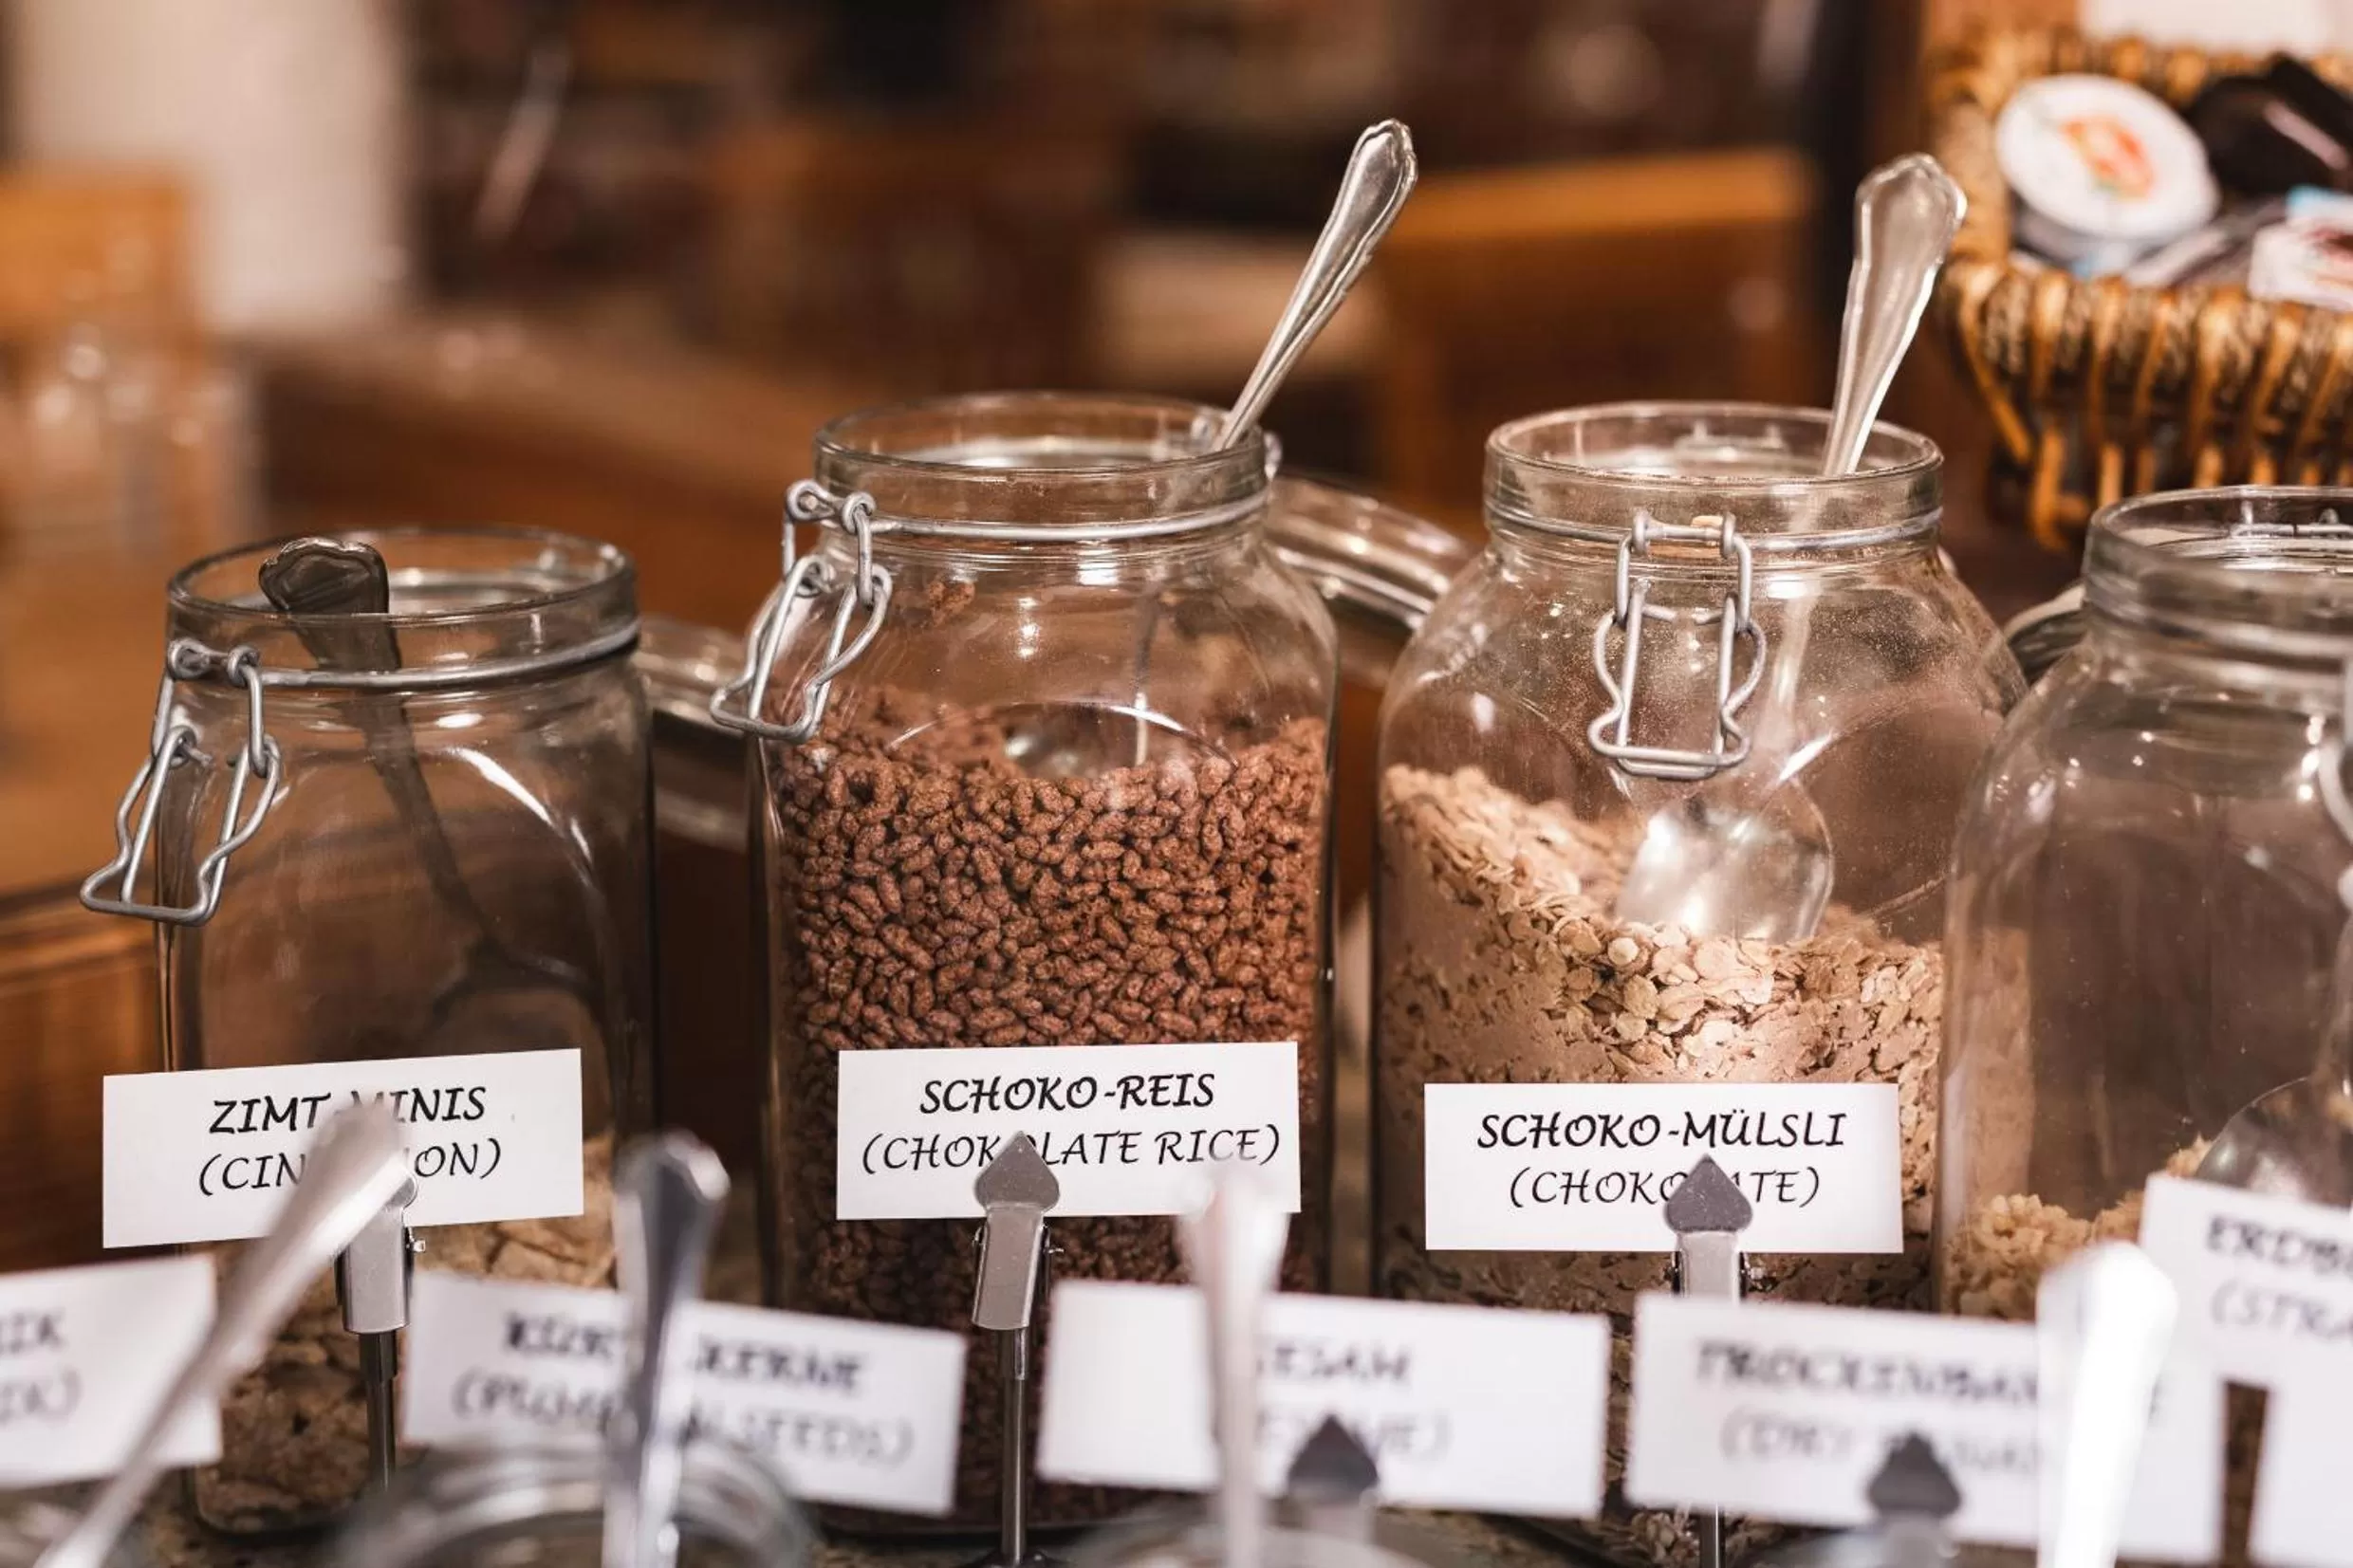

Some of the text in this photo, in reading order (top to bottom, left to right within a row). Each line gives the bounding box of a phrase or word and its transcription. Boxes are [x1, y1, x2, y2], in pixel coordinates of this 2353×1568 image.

[209, 1093, 331, 1134] ZIMT
[919, 1073, 1215, 1114] SCHOKO-REIS
[862, 1124, 1280, 1174] (CHOKLATE RICE)
[1476, 1108, 1846, 1149] SCHOKO-MÜLSLI
[198, 1137, 501, 1197] (CINON)
